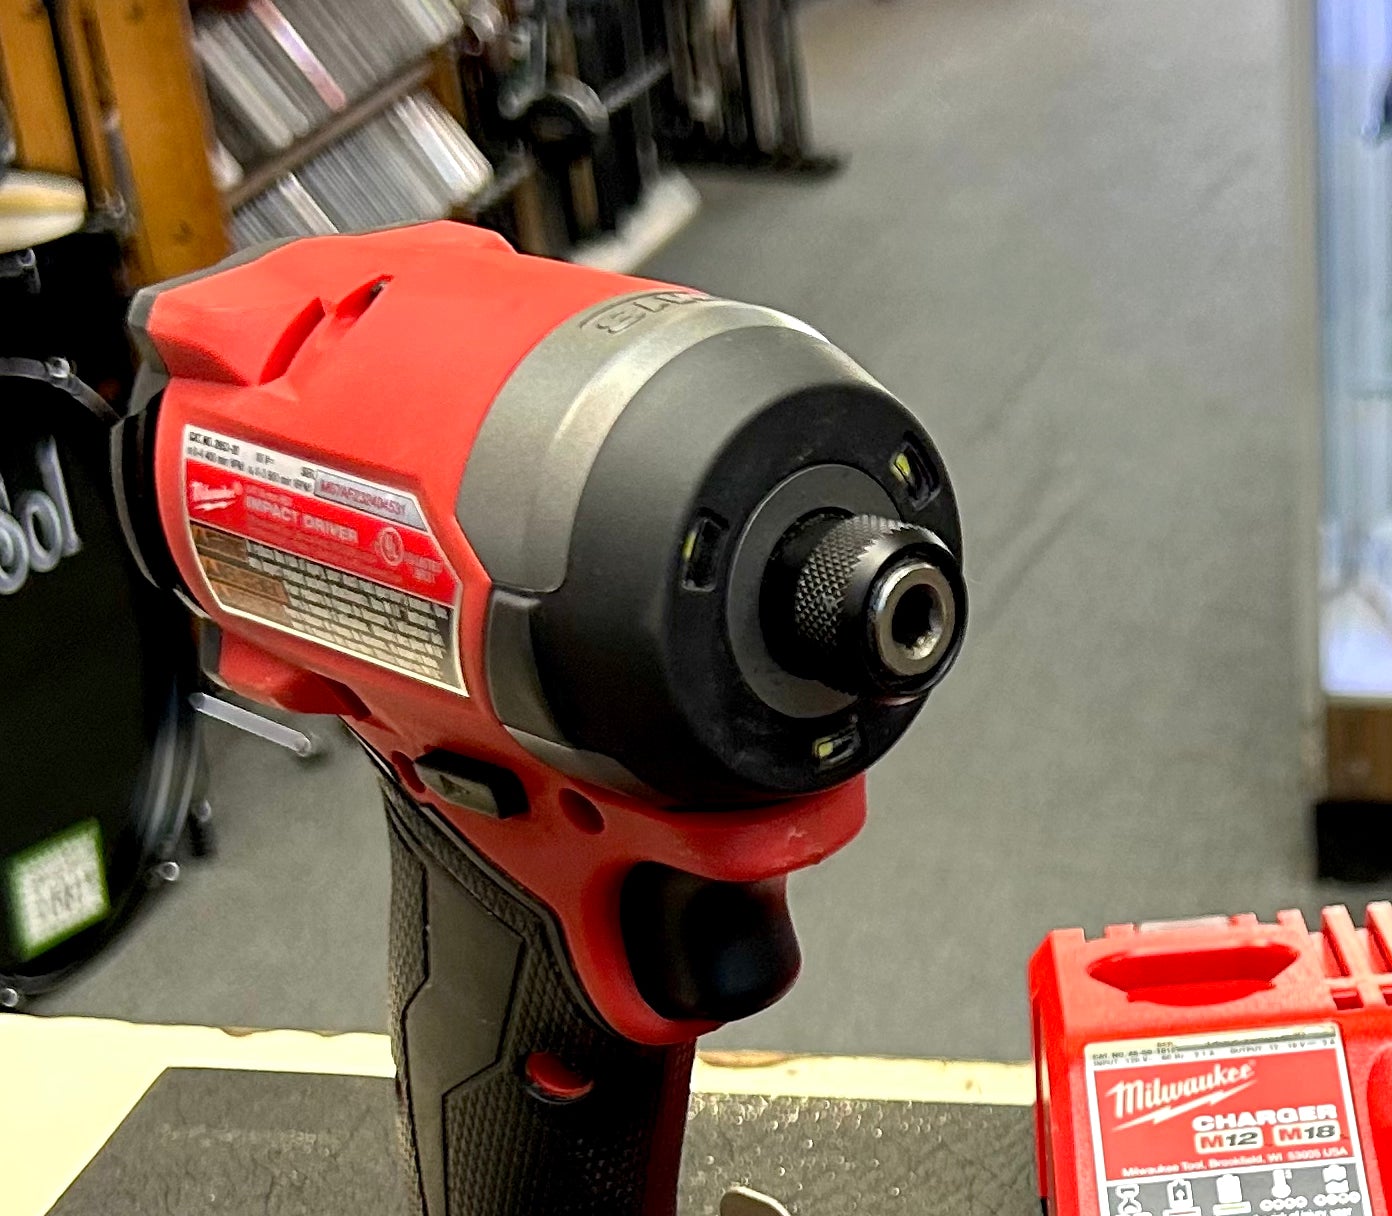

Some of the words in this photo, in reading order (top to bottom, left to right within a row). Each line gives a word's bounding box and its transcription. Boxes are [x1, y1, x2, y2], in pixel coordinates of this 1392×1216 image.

[302, 515, 358, 546] DRIVER
[1106, 1062, 1255, 1118] Milwaukee
[1193, 1104, 1338, 1131] CHARGER
[1200, 1134, 1258, 1149] M12
[1278, 1125, 1336, 1142] M18
[1122, 1162, 1179, 1177] Milwaukee
[1322, 1144, 1347, 1156] USA
